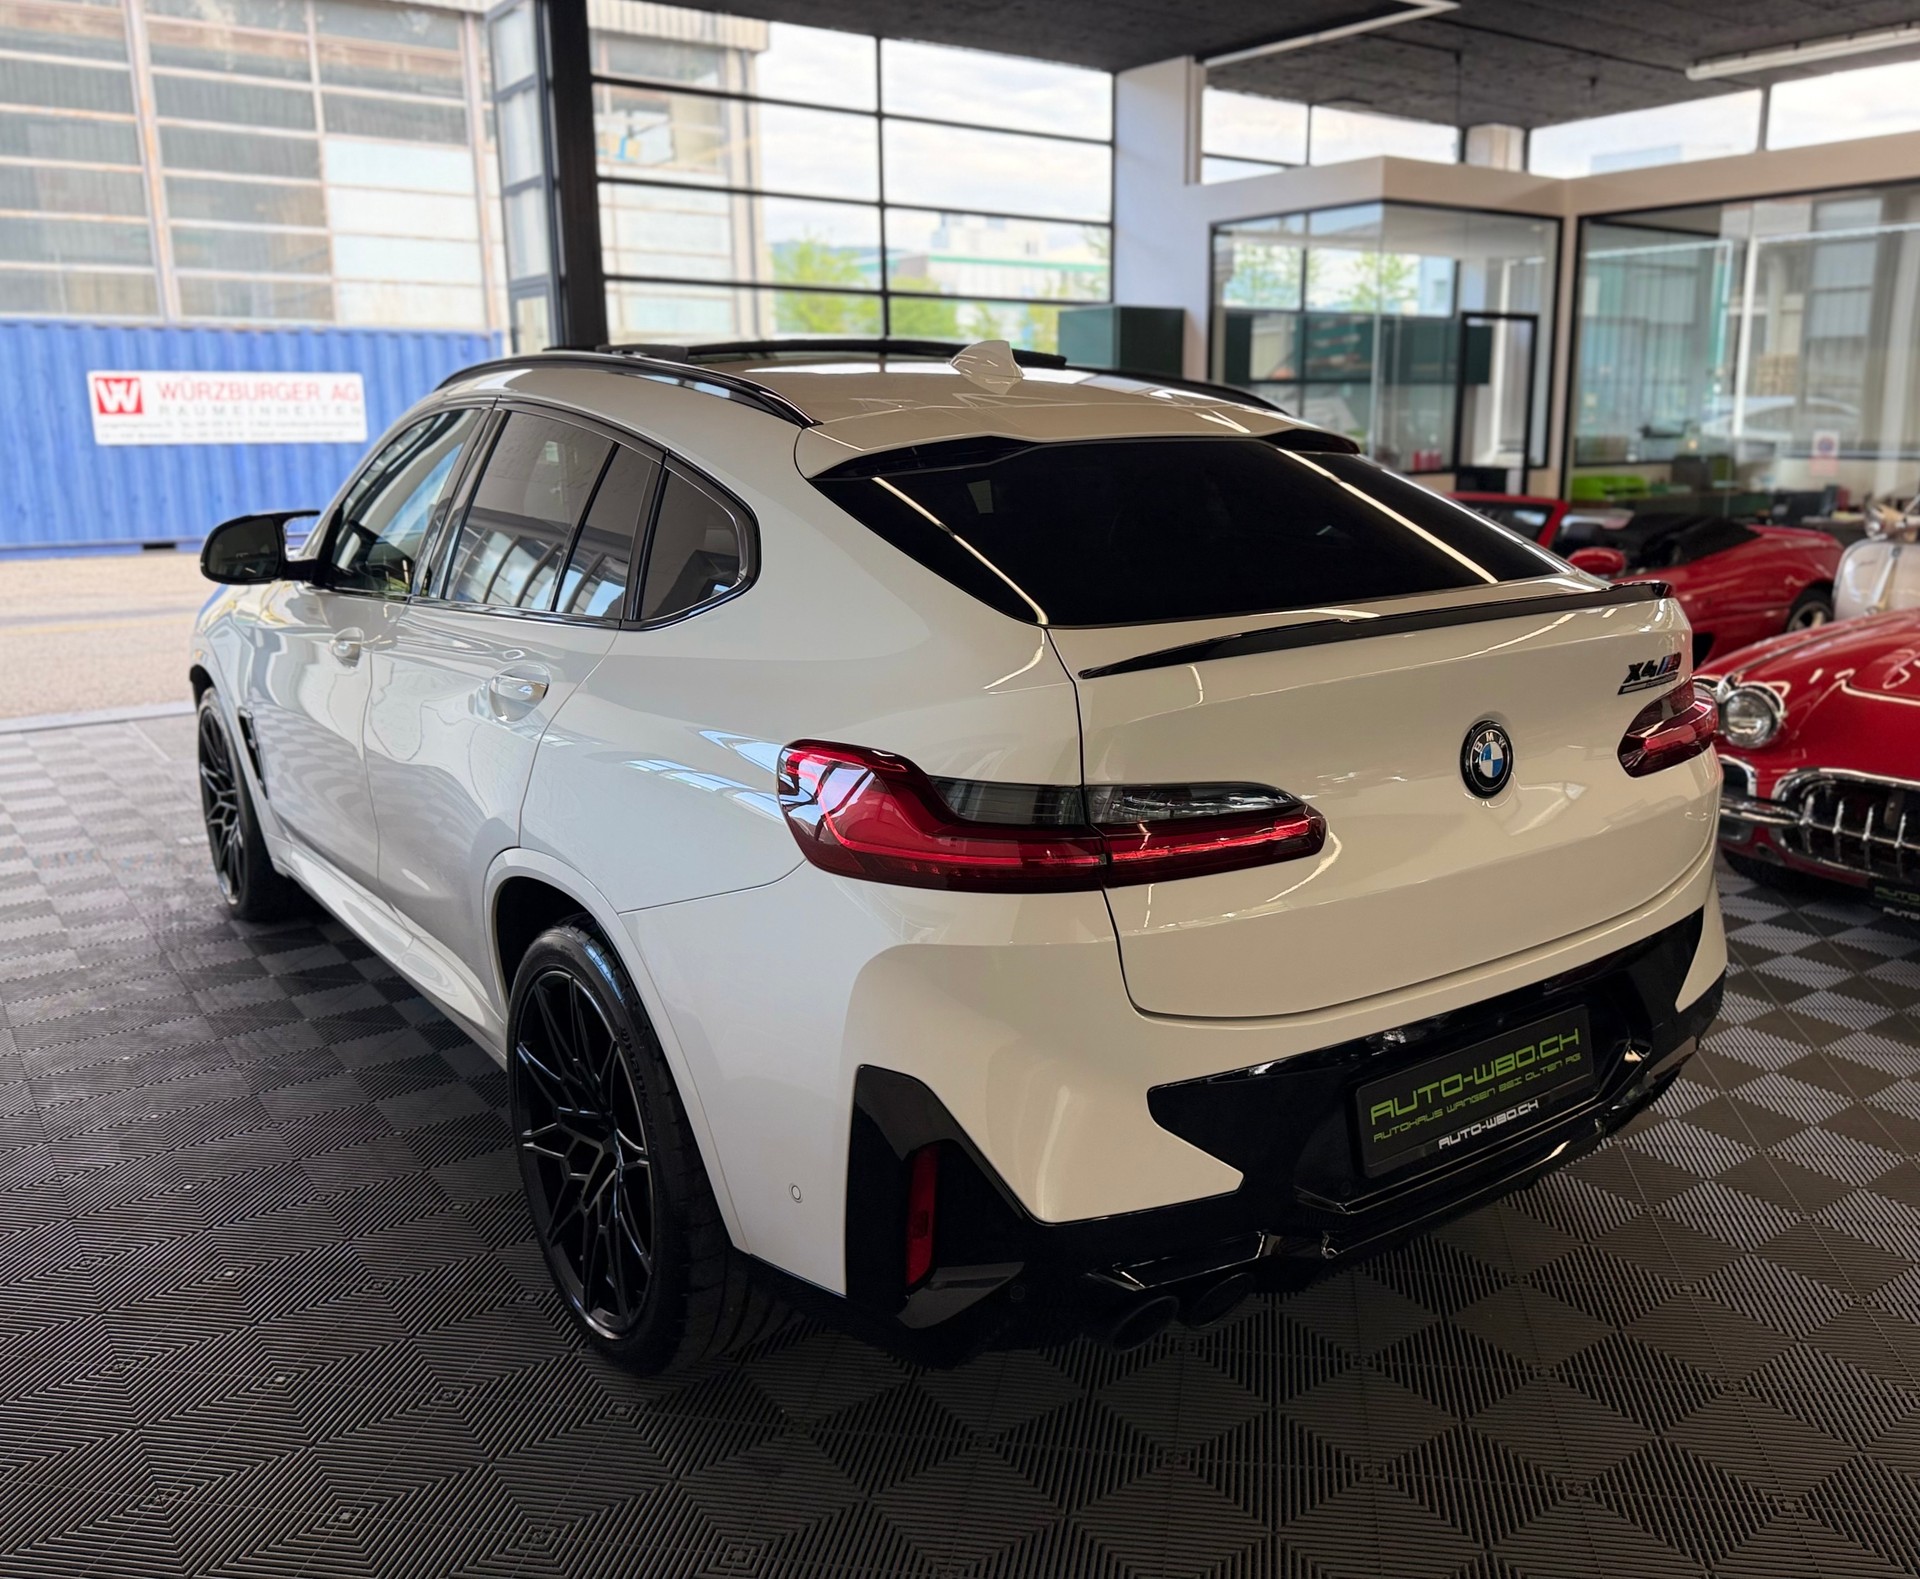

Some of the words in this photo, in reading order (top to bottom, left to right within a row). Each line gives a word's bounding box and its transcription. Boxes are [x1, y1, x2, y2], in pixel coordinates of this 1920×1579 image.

[95, 378, 141, 413] W
[156, 375, 320, 401] WÜRZBURGER
[331, 382, 361, 401] AG
[1474, 732, 1506, 752] BMW
[1371, 1027, 1579, 1125] AUTO-WBO.CH
[1374, 1108, 1443, 1142] AUTOHAUS
[1446, 1087, 1496, 1113] WANGEN
[1499, 1076, 1522, 1092] BEI
[1525, 1060, 1562, 1081] OLTEN
[1438, 1099, 1539, 1149] AUTO-WBO.CH
